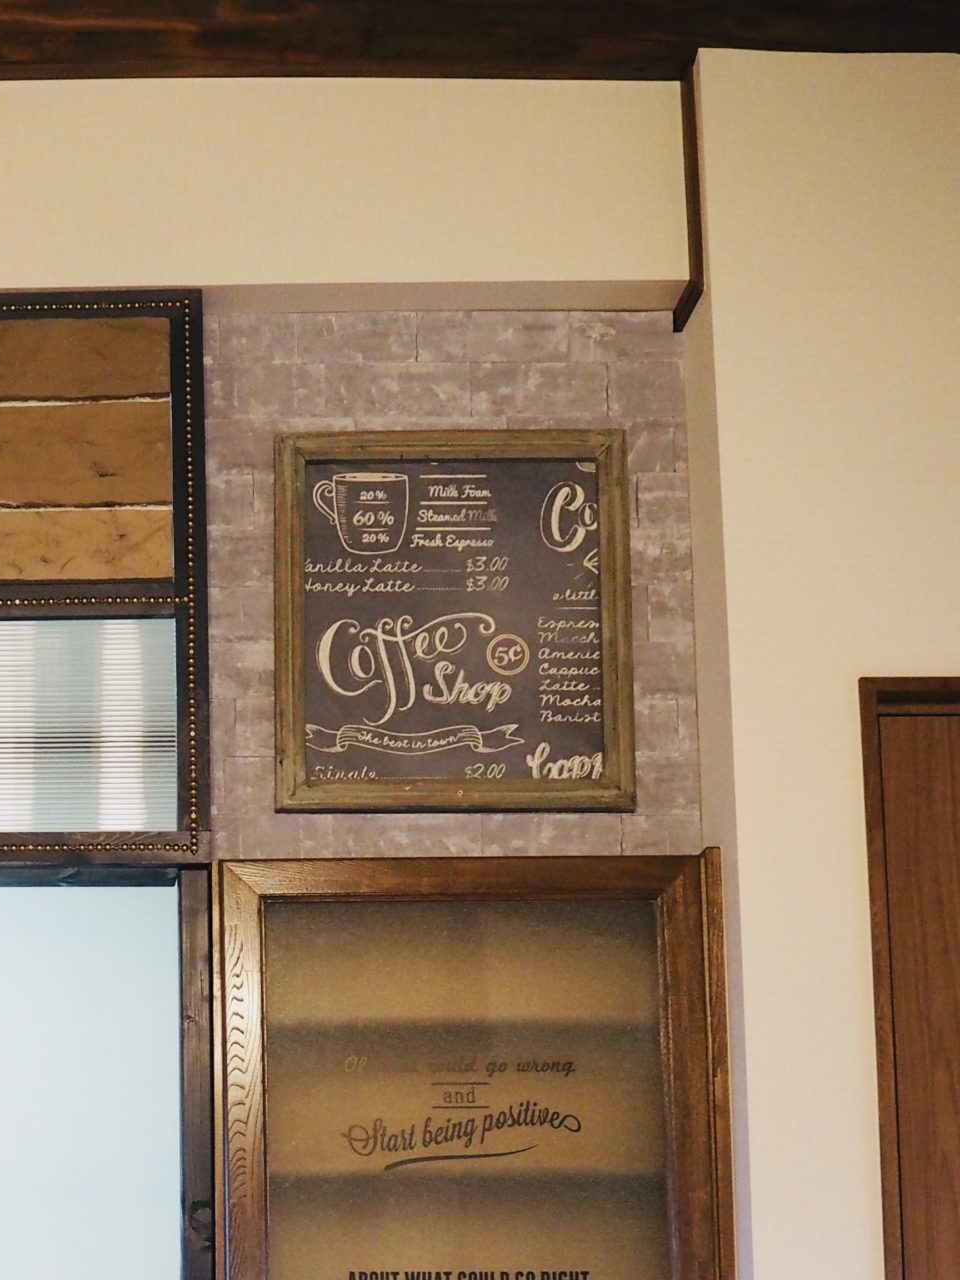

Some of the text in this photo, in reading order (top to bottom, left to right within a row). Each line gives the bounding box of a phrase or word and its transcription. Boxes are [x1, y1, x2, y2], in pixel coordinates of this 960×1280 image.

[359, 489, 387, 501] 20%
[429, 484, 492, 499] Milk Foam
[353, 510, 395, 526] 60%
[361, 532, 390, 544] 20%
[409, 533, 495, 552] Fresh Espresso
[369, 558, 423, 574] Latte
[466, 556, 509, 573] $3.00
[362, 577, 416, 593] Latte
[466, 576, 509, 592] $3.00
[564, 588, 599, 602] littl
[315, 611, 496, 726] Coffee
[422, 660, 512, 712] Shop
[539, 679, 591, 692] Latte
[540, 694, 601, 708] Mocha
[358, 731, 460, 749] The best in town
[464, 763, 507, 779] $2.00
[485, 1060, 508, 1078] go
[516, 1060, 576, 1078] wrong
[442, 1086, 477, 1105] and
[341, 1099, 582, 1157] Start being positive
